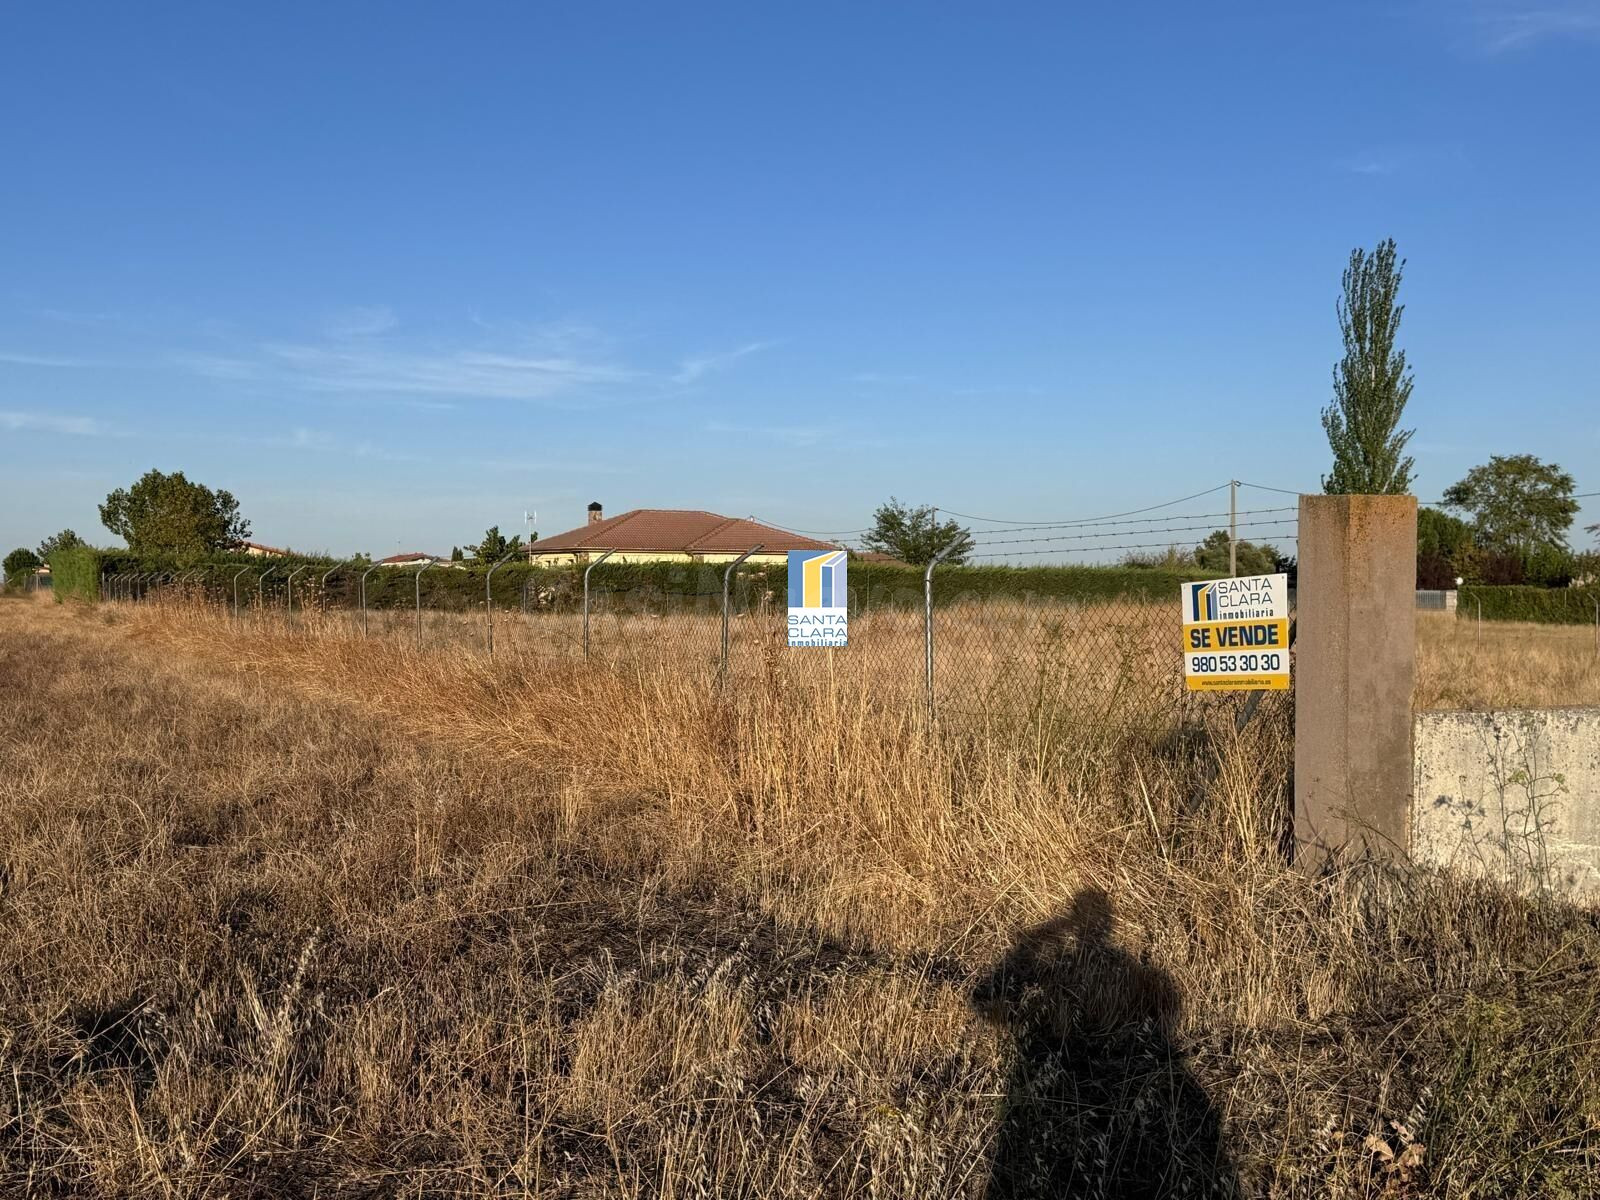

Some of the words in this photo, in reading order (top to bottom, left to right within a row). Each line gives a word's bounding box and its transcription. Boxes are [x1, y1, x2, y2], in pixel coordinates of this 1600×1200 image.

[1218, 578, 1273, 594] SANTA
[1219, 592, 1273, 608] CLARA
[1219, 608, 1274, 620] inmobiliaria
[1190, 628, 1211, 648] SE
[1216, 624, 1279, 647] VENDE
[1192, 656, 1217, 673] 980
[1220, 655, 1237, 672] 53
[1240, 655, 1258, 671] 30
[1261, 654, 1280, 670] 30
